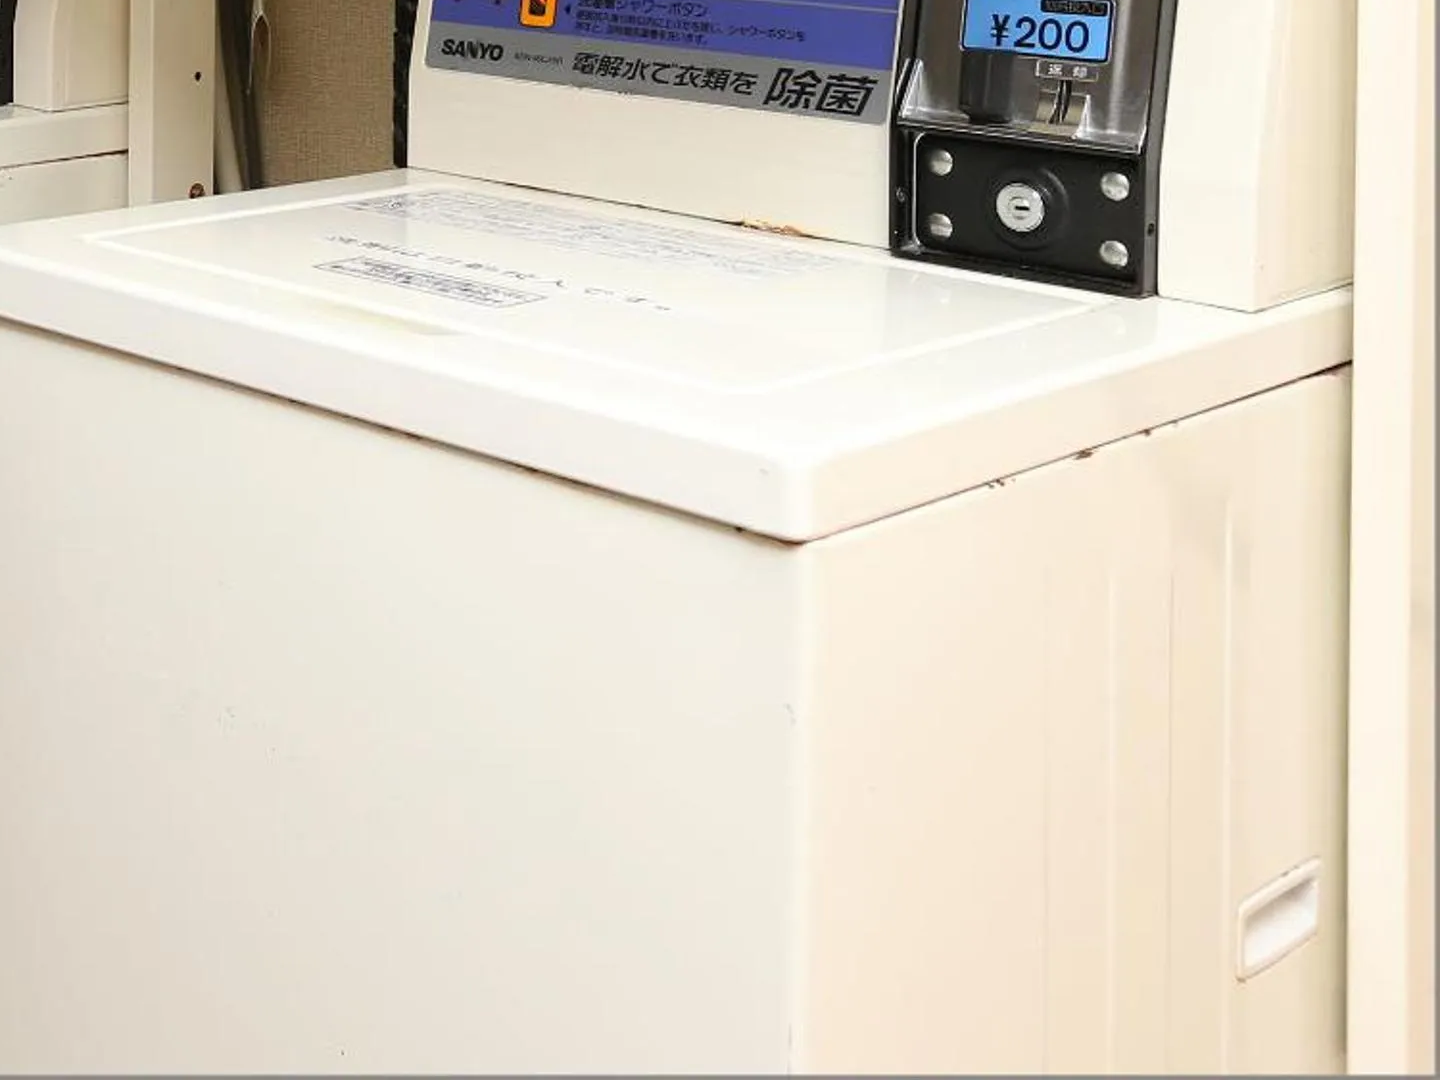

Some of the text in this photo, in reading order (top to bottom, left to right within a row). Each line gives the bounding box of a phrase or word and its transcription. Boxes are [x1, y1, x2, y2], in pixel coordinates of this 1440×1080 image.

[991, 14, 1089, 53] ¥200
[441, 39, 879, 117] SANYO 電解水で衣類を 除菌
